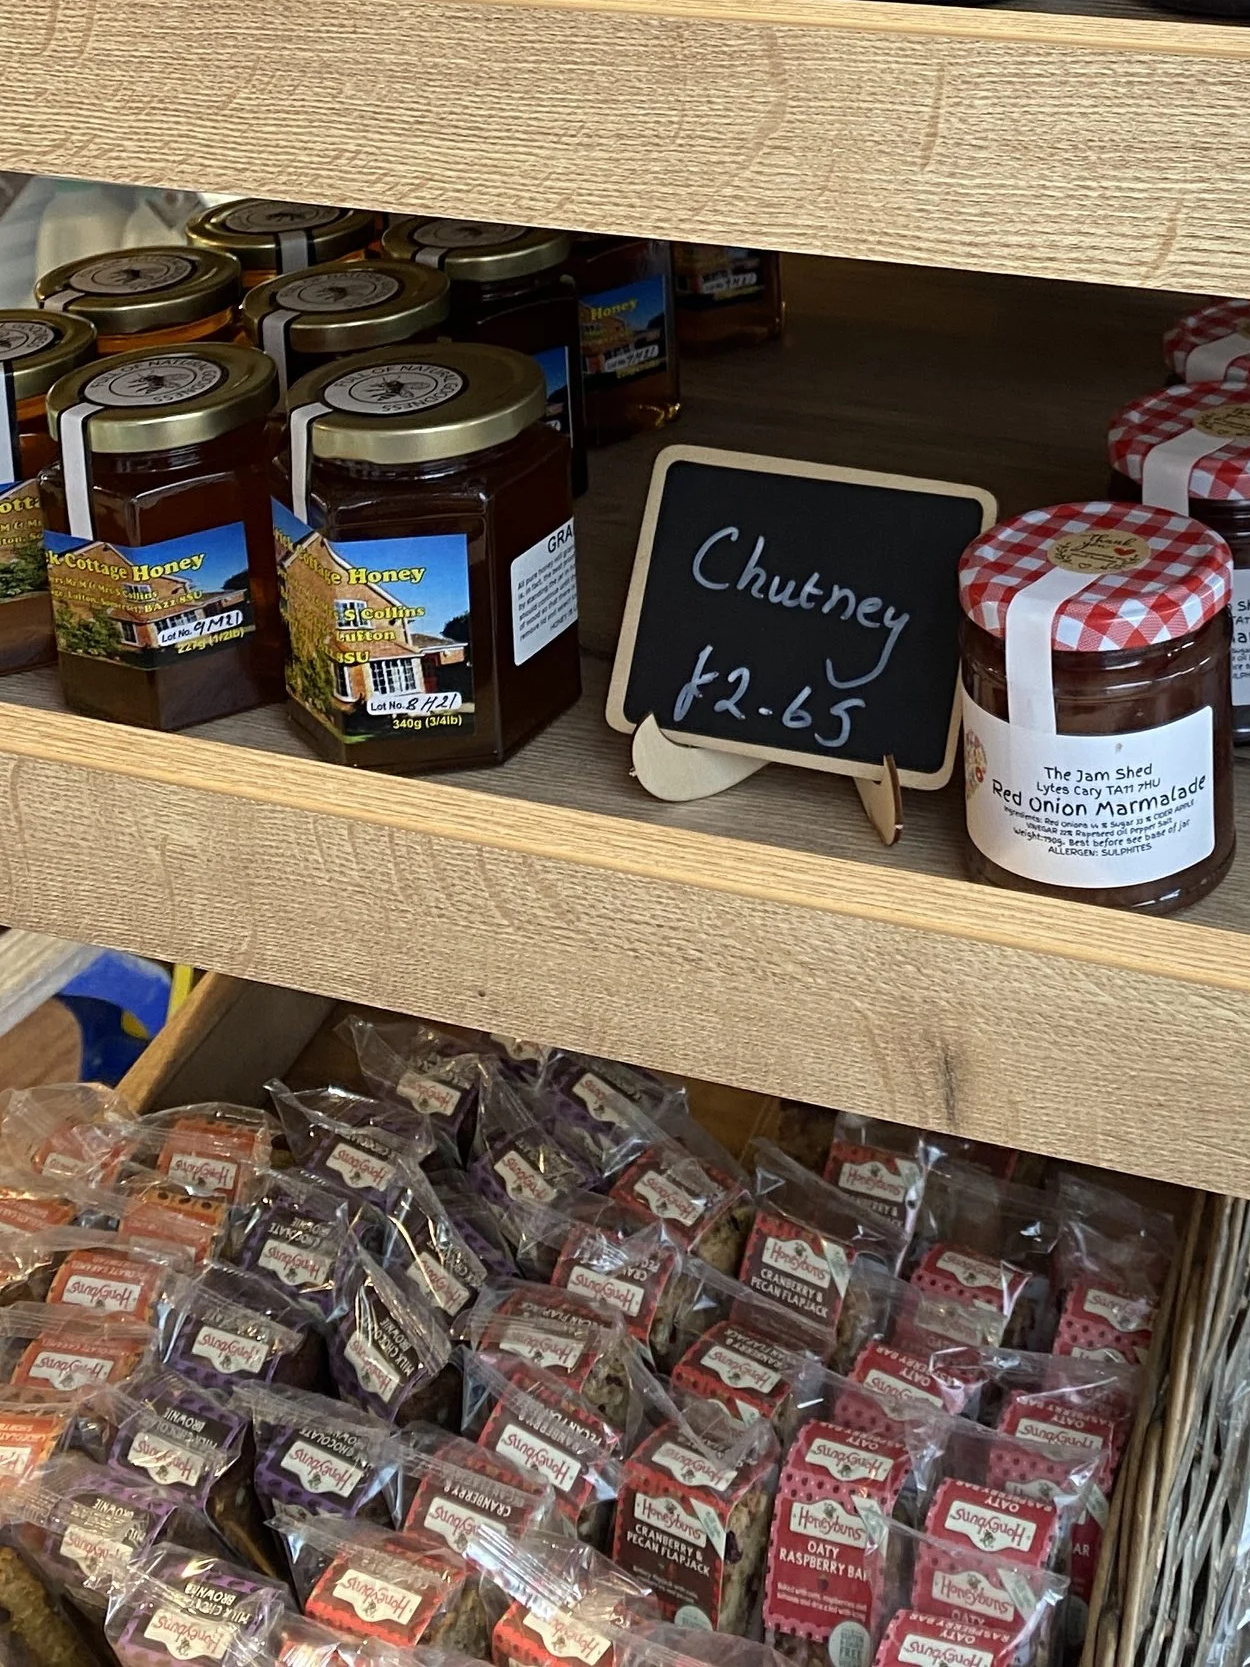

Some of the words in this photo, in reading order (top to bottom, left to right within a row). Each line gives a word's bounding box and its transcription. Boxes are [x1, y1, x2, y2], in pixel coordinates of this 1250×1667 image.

[591, 298, 638, 320] Honey
[64, 554, 128, 581] Cottage
[132, 552, 205, 582] Honey
[348, 568, 425, 584] Honey
[361, 606, 425, 619] Collins
[692, 526, 910, 689] Chutney
[161, 633, 175, 643] Lot
[371, 702, 387, 711] Lot
[389, 701, 404, 710] No.
[673, 644, 866, 748] £2.65
[393, 719, 422, 729] 340g
[1044, 767, 1071, 781] The
[1077, 770, 1109, 782] Jam
[1116, 763, 1152, 779] Shed
[992, 779, 1022, 806] Red
[1029, 797, 1087, 817] Onion
[1096, 775, 1206, 817] Marmalade
[1037, 782, 1069, 795] Lytes
[1074, 786, 1101, 799] Cary
[1048, 847, 1098, 856] ALLERGEN:
[1101, 843, 1152, 856] SULPHITES
[771, 1242, 828, 1283] Honeybuns
[71, 1282, 130, 1303] Honeybuns
[751, 1276, 780, 1298] PECAN
[781, 1290, 828, 1318] FLAPJACK
[760, 1268, 812, 1296] CRANBERRY
[291, 1448, 351, 1490] Honeybuns
[505, 1433, 572, 1486] Honeybuns
[816, 1444, 884, 1477] Honeybuns
[642, 1497, 701, 1540] Honeybuns
[985, 1495, 1020, 1512] OATY
[635, 1524, 694, 1555] CRANBERRY
[799, 1510, 867, 1541] Honeybuns
[955, 1507, 1027, 1546] Honeybuns
[627, 1533, 659, 1555] PECAN
[661, 1545, 710, 1576] FLAPJACK
[779, 1548, 845, 1577] RASPBERRY
[807, 1541, 840, 1559] OATY
[343, 1570, 418, 1620] Honeybuns
